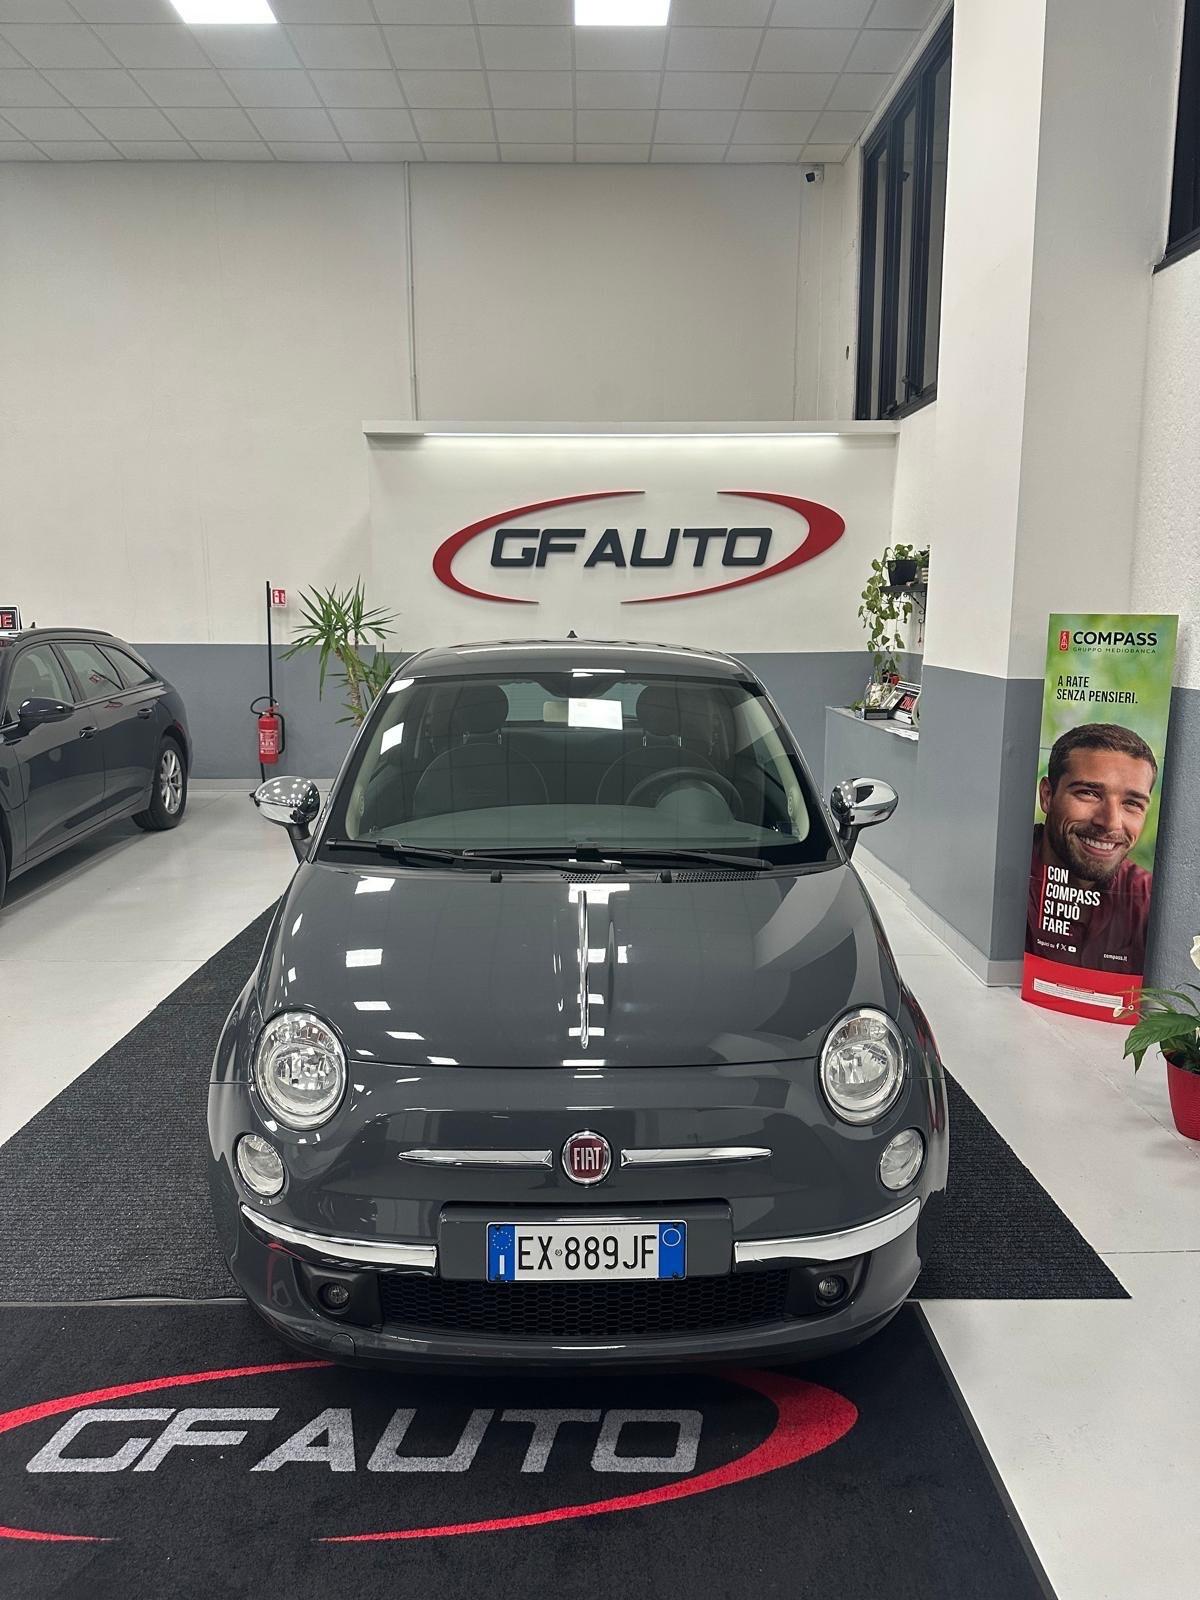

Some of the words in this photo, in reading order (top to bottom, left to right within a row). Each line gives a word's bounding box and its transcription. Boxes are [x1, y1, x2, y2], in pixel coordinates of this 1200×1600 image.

[490, 527, 587, 568] GF
[583, 527, 774, 568] AUTO
[0, 613, 13, 628] E
[1072, 631, 1158, 646] COMPASS
[1057, 675, 1064, 687] A
[1065, 675, 1090, 688] RATE
[1056, 688, 1086, 702] SENZA
[1088, 690, 1139, 704] PENSIERI.
[1047, 865, 1069, 884] CON
[1045, 883, 1101, 907] COMPASS
[1043, 899, 1054, 916] SI
[1056, 902, 1080, 921] PUÒ
[1103, 953, 1128, 962] compass.it
[573, 1147, 602, 1170] FIAT
[25, 1407, 280, 1473] GF
[250, 1408, 704, 1474] AUTO
